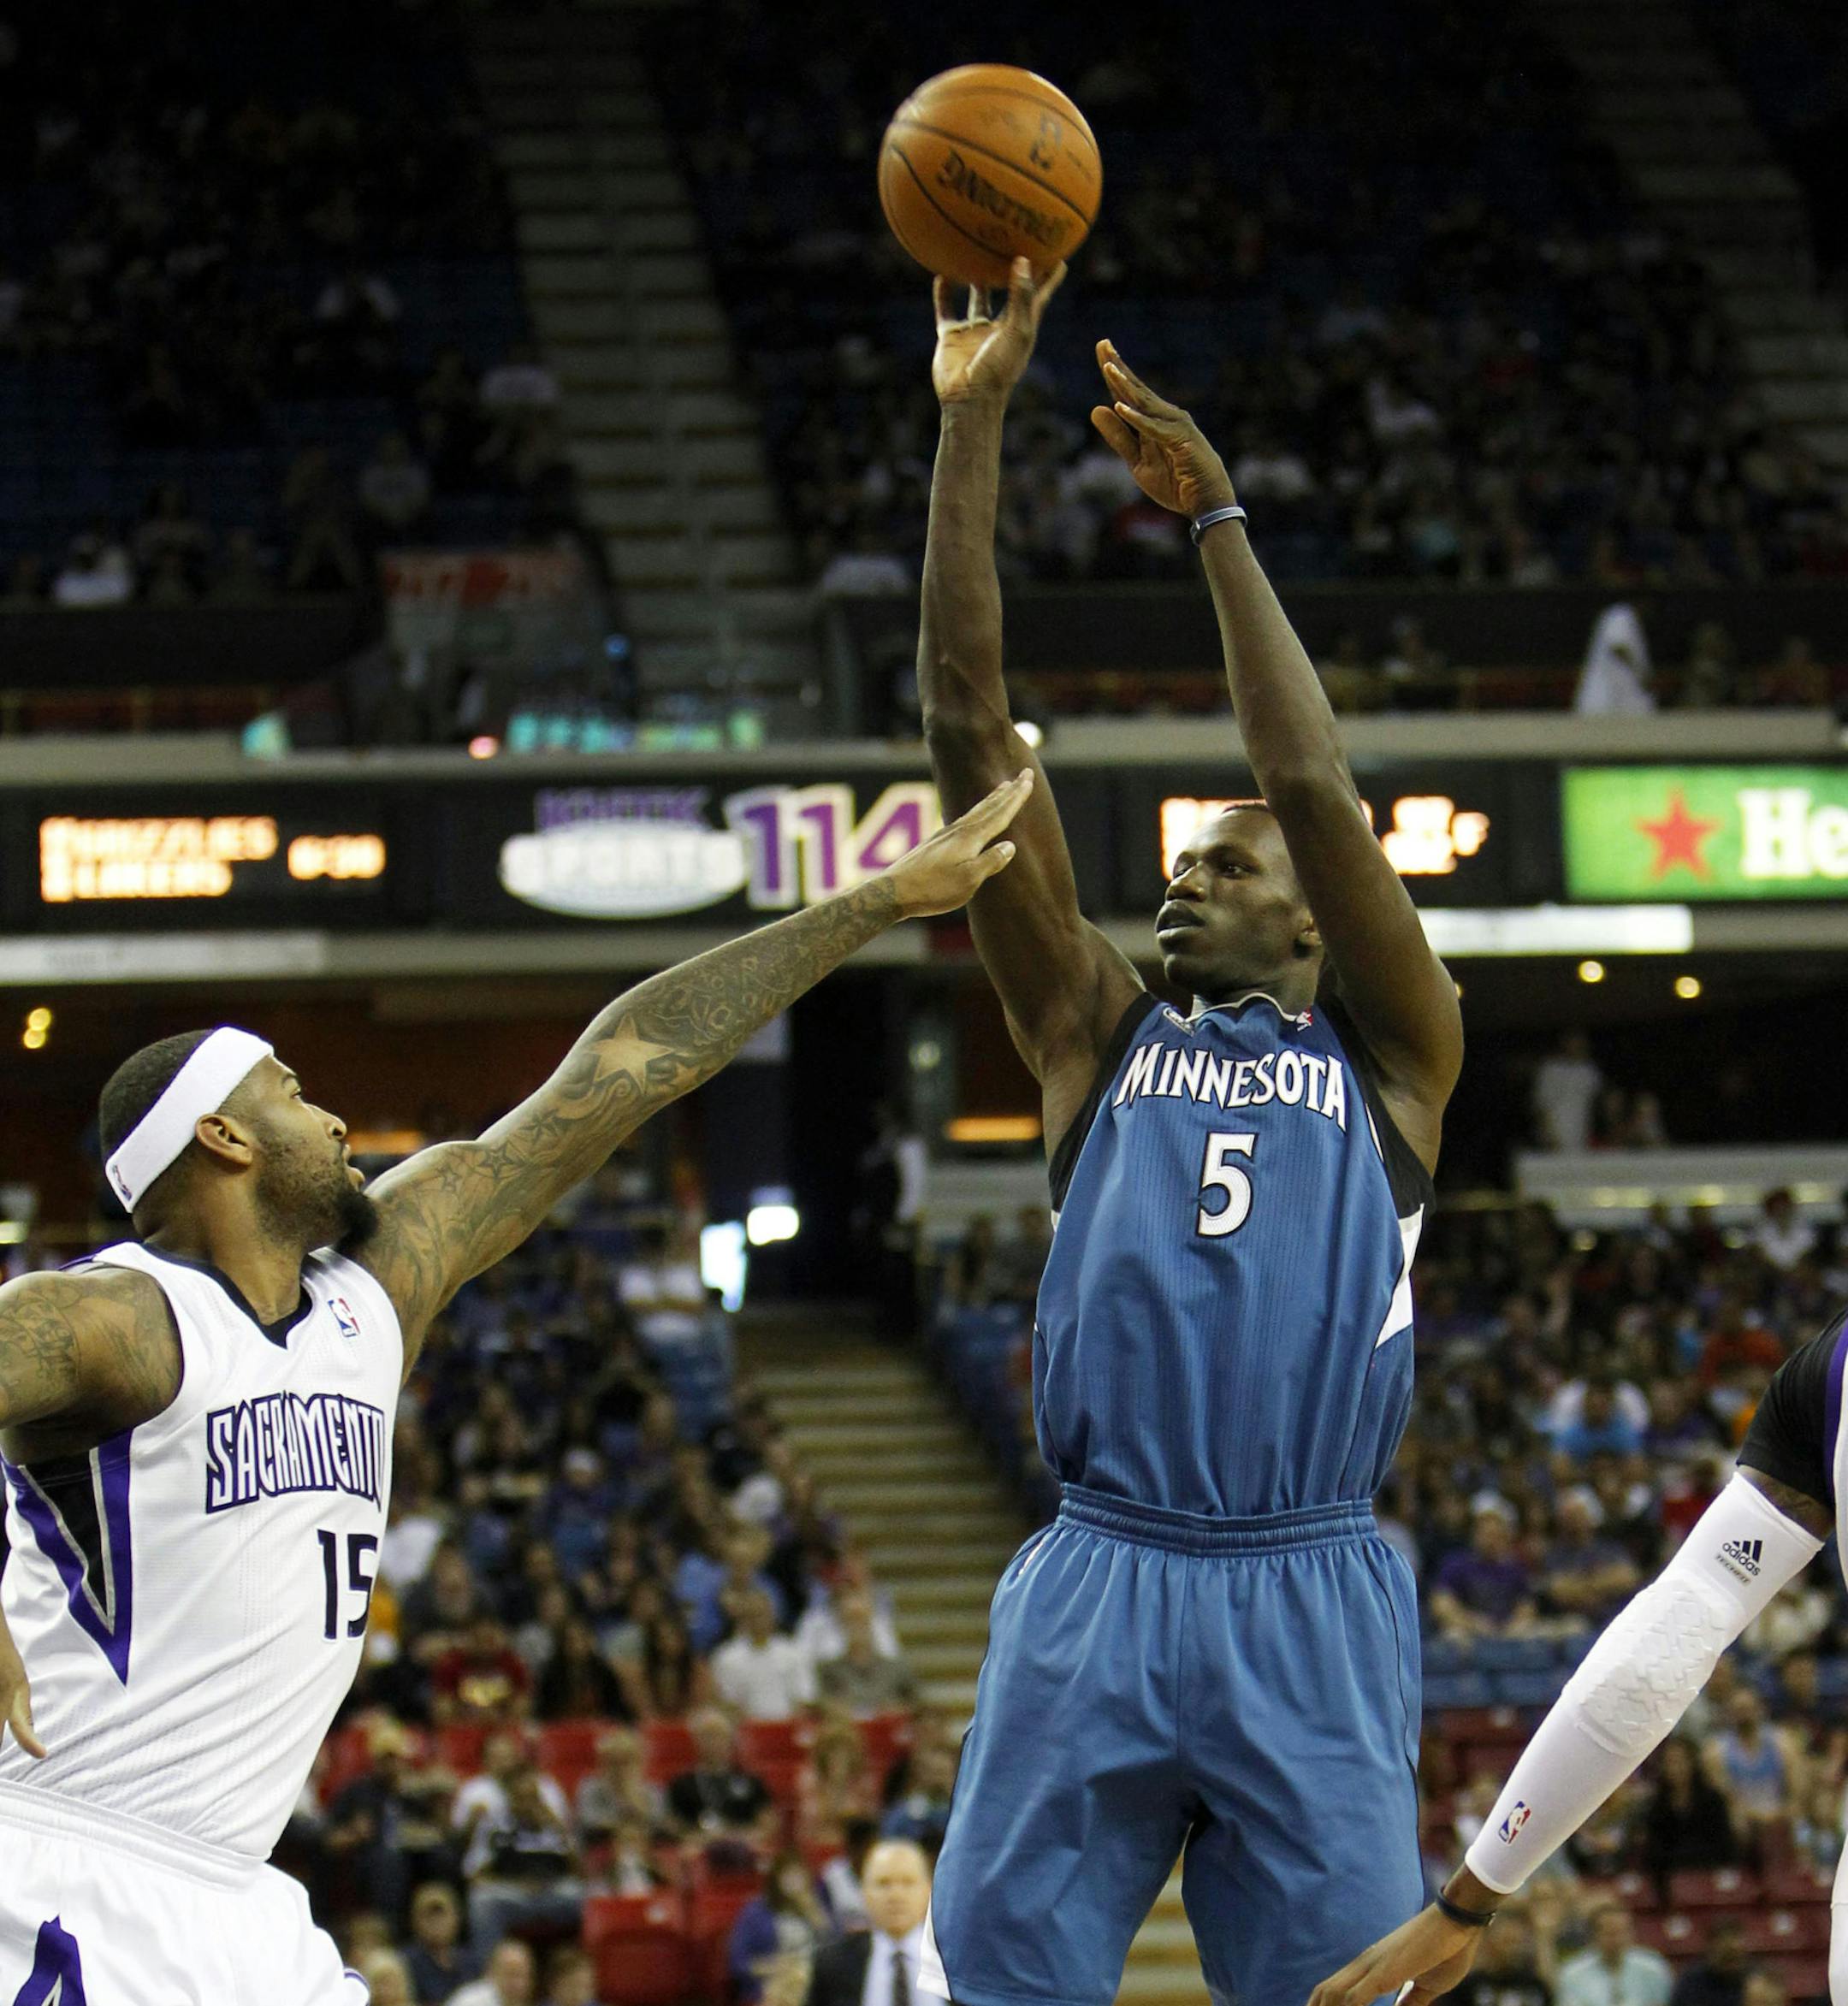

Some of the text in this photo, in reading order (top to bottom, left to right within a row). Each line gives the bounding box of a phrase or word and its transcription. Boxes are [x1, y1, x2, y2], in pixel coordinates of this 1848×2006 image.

[1113, 1041, 1347, 1133] MINNESOTA
[1195, 1129, 1259, 1240] 5
[205, 1390, 384, 1513] SACRAMENTO
[317, 1529, 378, 1640] 15
[1721, 1542, 1761, 1576] adidas
